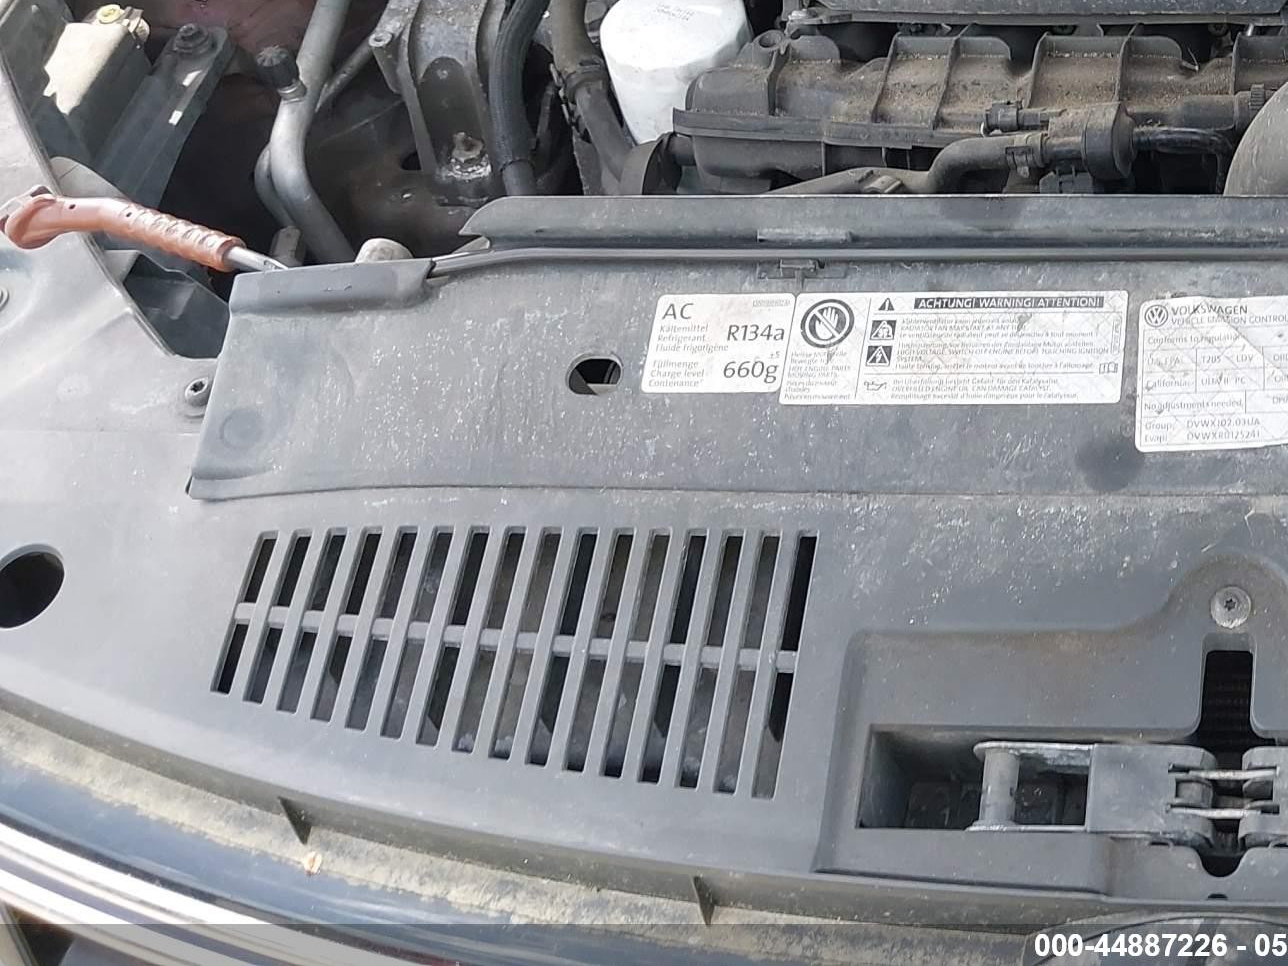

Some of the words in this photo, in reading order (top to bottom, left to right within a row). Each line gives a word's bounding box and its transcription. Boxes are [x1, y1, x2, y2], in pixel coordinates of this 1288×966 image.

[918, 298, 976, 309] ACHTUNG!
[979, 297, 1035, 309] WARNING!
[1037, 297, 1100, 307] ATTENTION!
[662, 303, 694, 320] AC
[1171, 305, 1248, 315] VOLKSWAGEN
[727, 325, 785, 341] R134a
[658, 335, 706, 344] Refrigerant
[1148, 336, 1188, 344] Conforms
[1236, 354, 1254, 362] LDV
[650, 370, 681, 379] Charge
[685, 370, 704, 378] level
[723, 361, 780, 384] 660g
